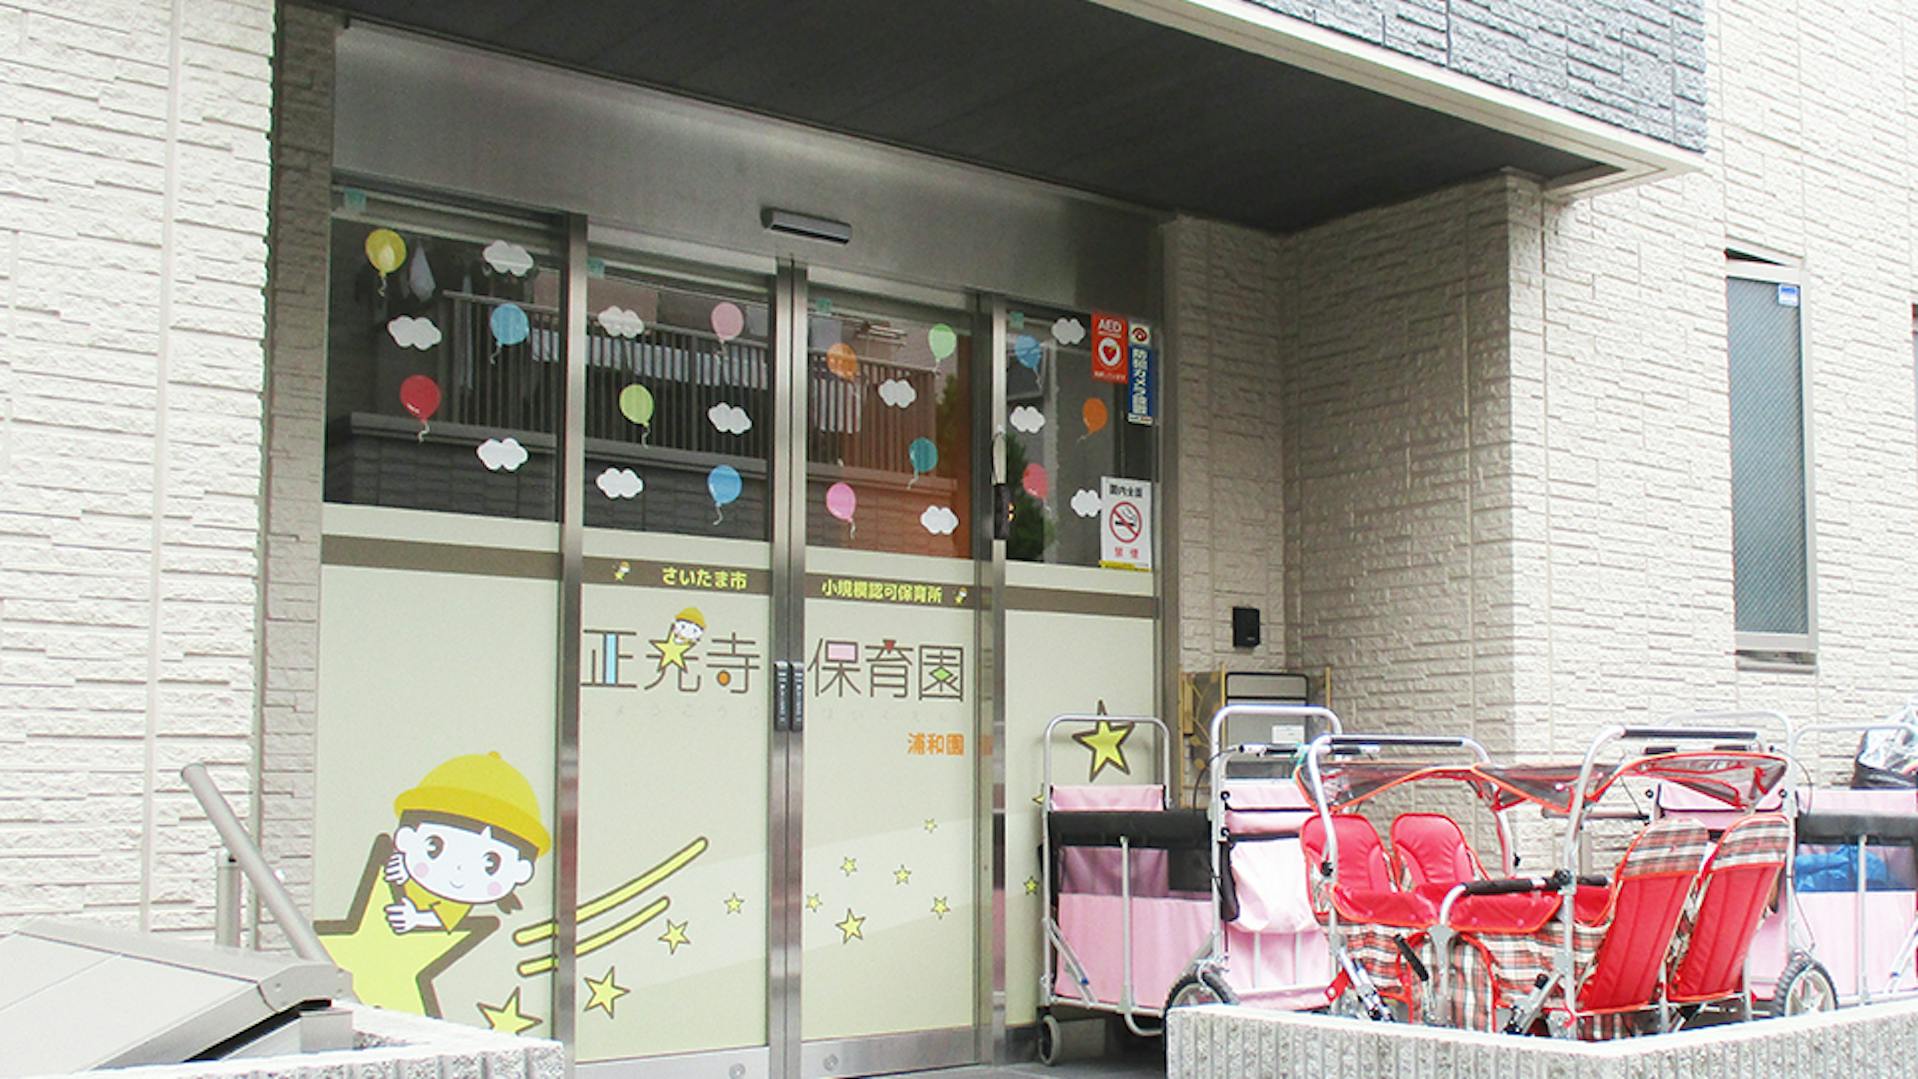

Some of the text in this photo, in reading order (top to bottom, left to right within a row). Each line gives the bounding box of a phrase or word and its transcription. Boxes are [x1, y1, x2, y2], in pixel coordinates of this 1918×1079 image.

[1098, 319, 1122, 333] AED
[663, 567, 942, 604] さいたま市 小規模認可保育所
[580, 625, 760, 693] 正光寺
[807, 638, 964, 702] 保育園
[907, 731, 964, 755] 浦和園
